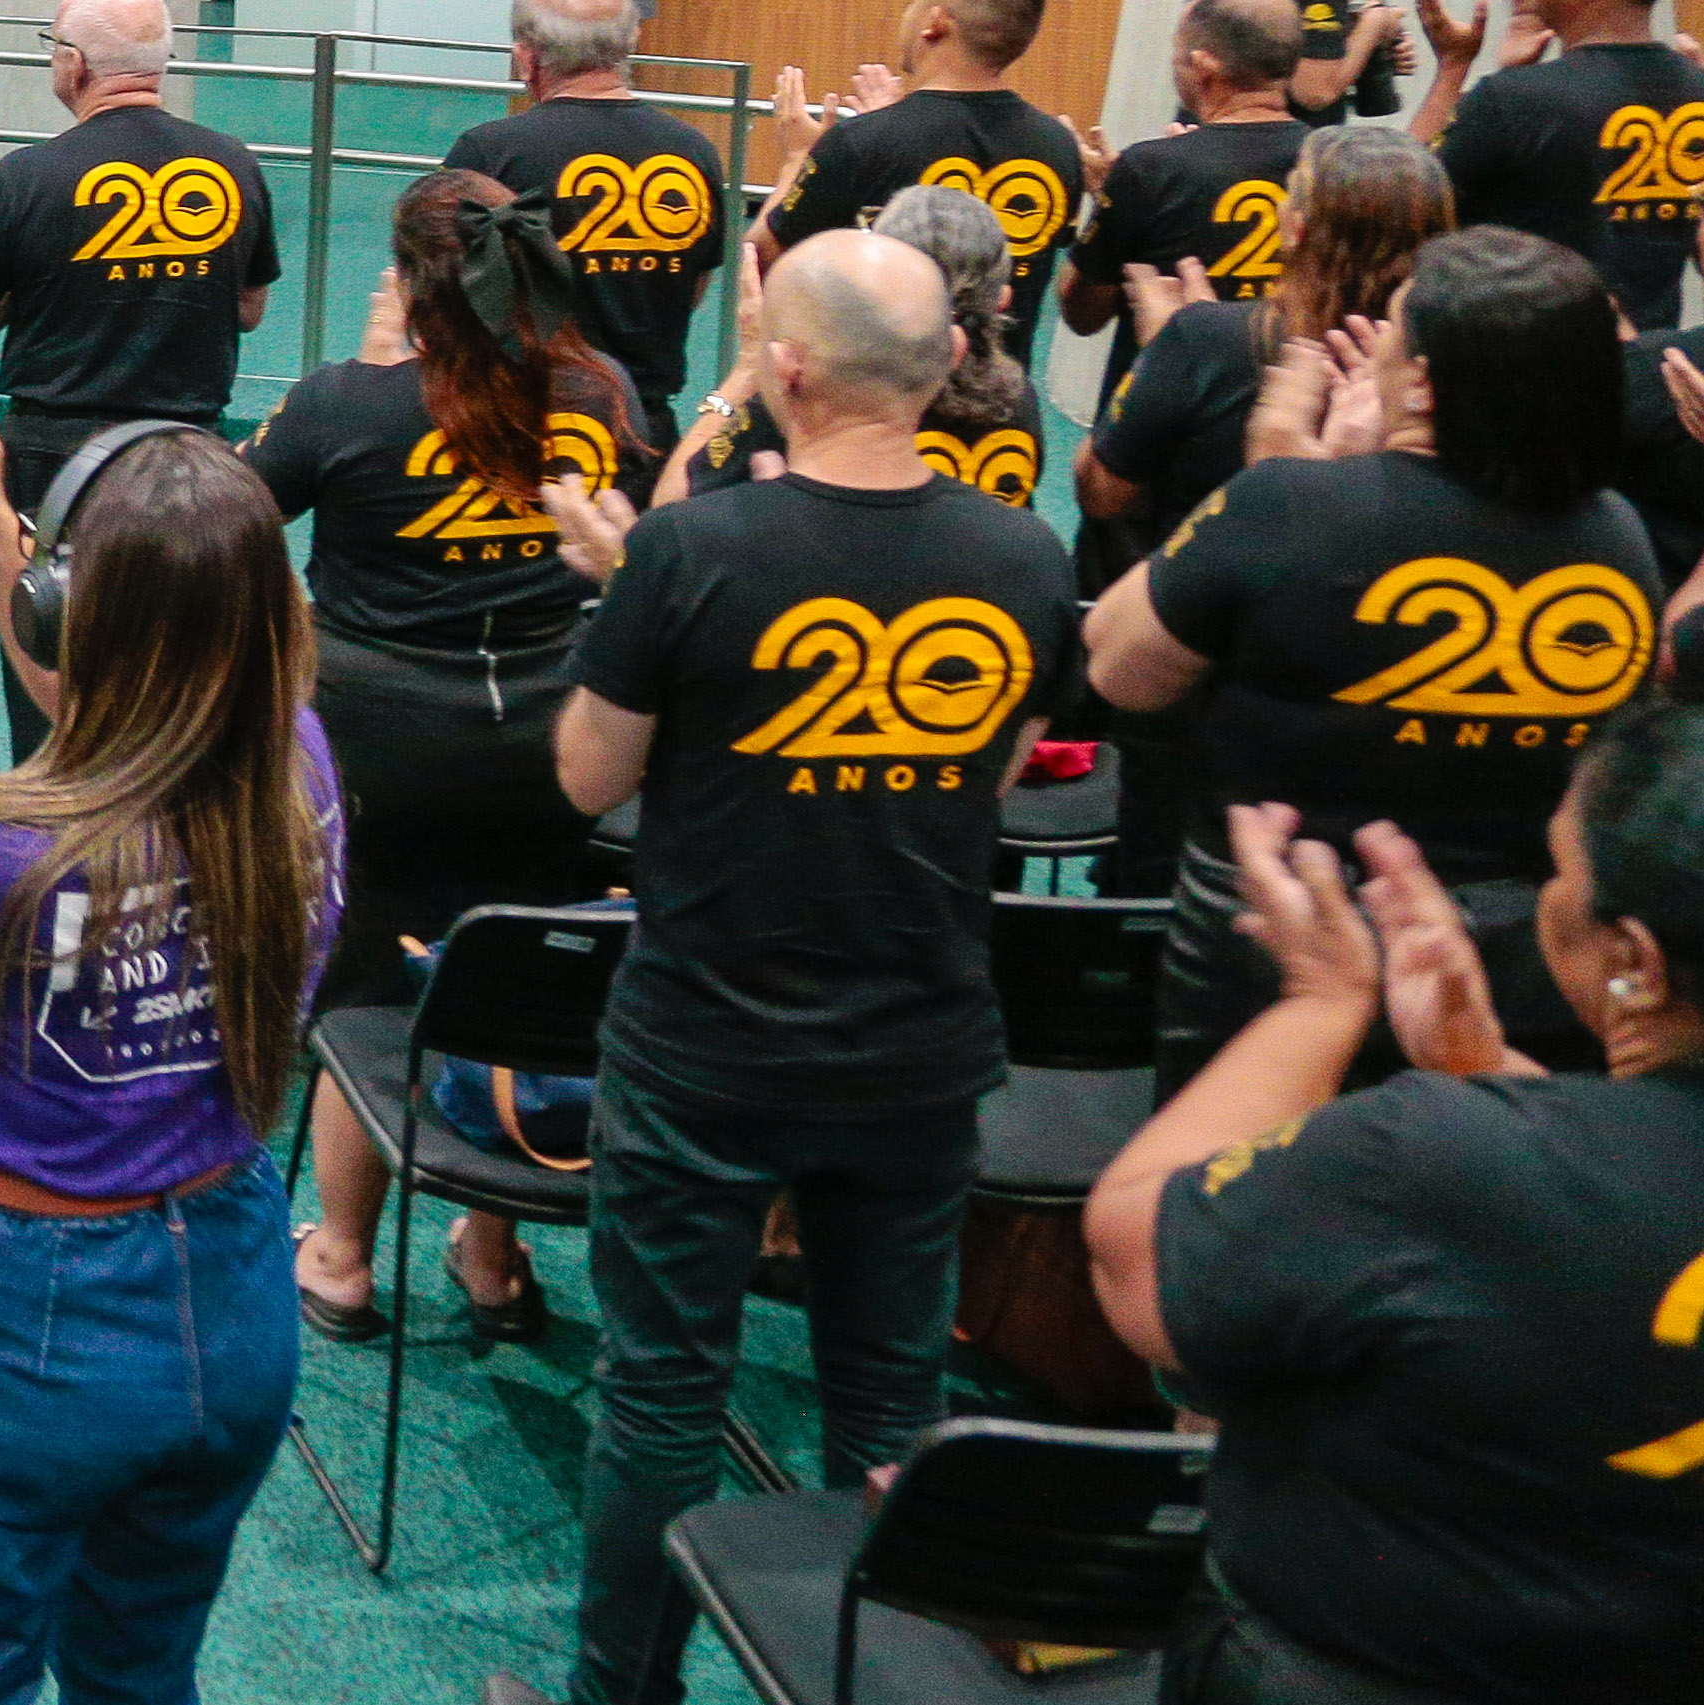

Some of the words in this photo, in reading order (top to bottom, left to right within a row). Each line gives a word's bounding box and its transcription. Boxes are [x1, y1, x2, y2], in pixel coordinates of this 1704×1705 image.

[73, 156, 242, 262] 20
[557, 153, 712, 253] 20
[108, 259, 210, 281] ANOS
[584, 256, 681, 274] ANOS
[443, 539, 545, 563] ANO
[1334, 556, 1655, 717] 20
[731, 596, 1033, 756] 20
[1394, 719, 1589, 748] ANOS
[787, 765, 961, 795] ANOS
